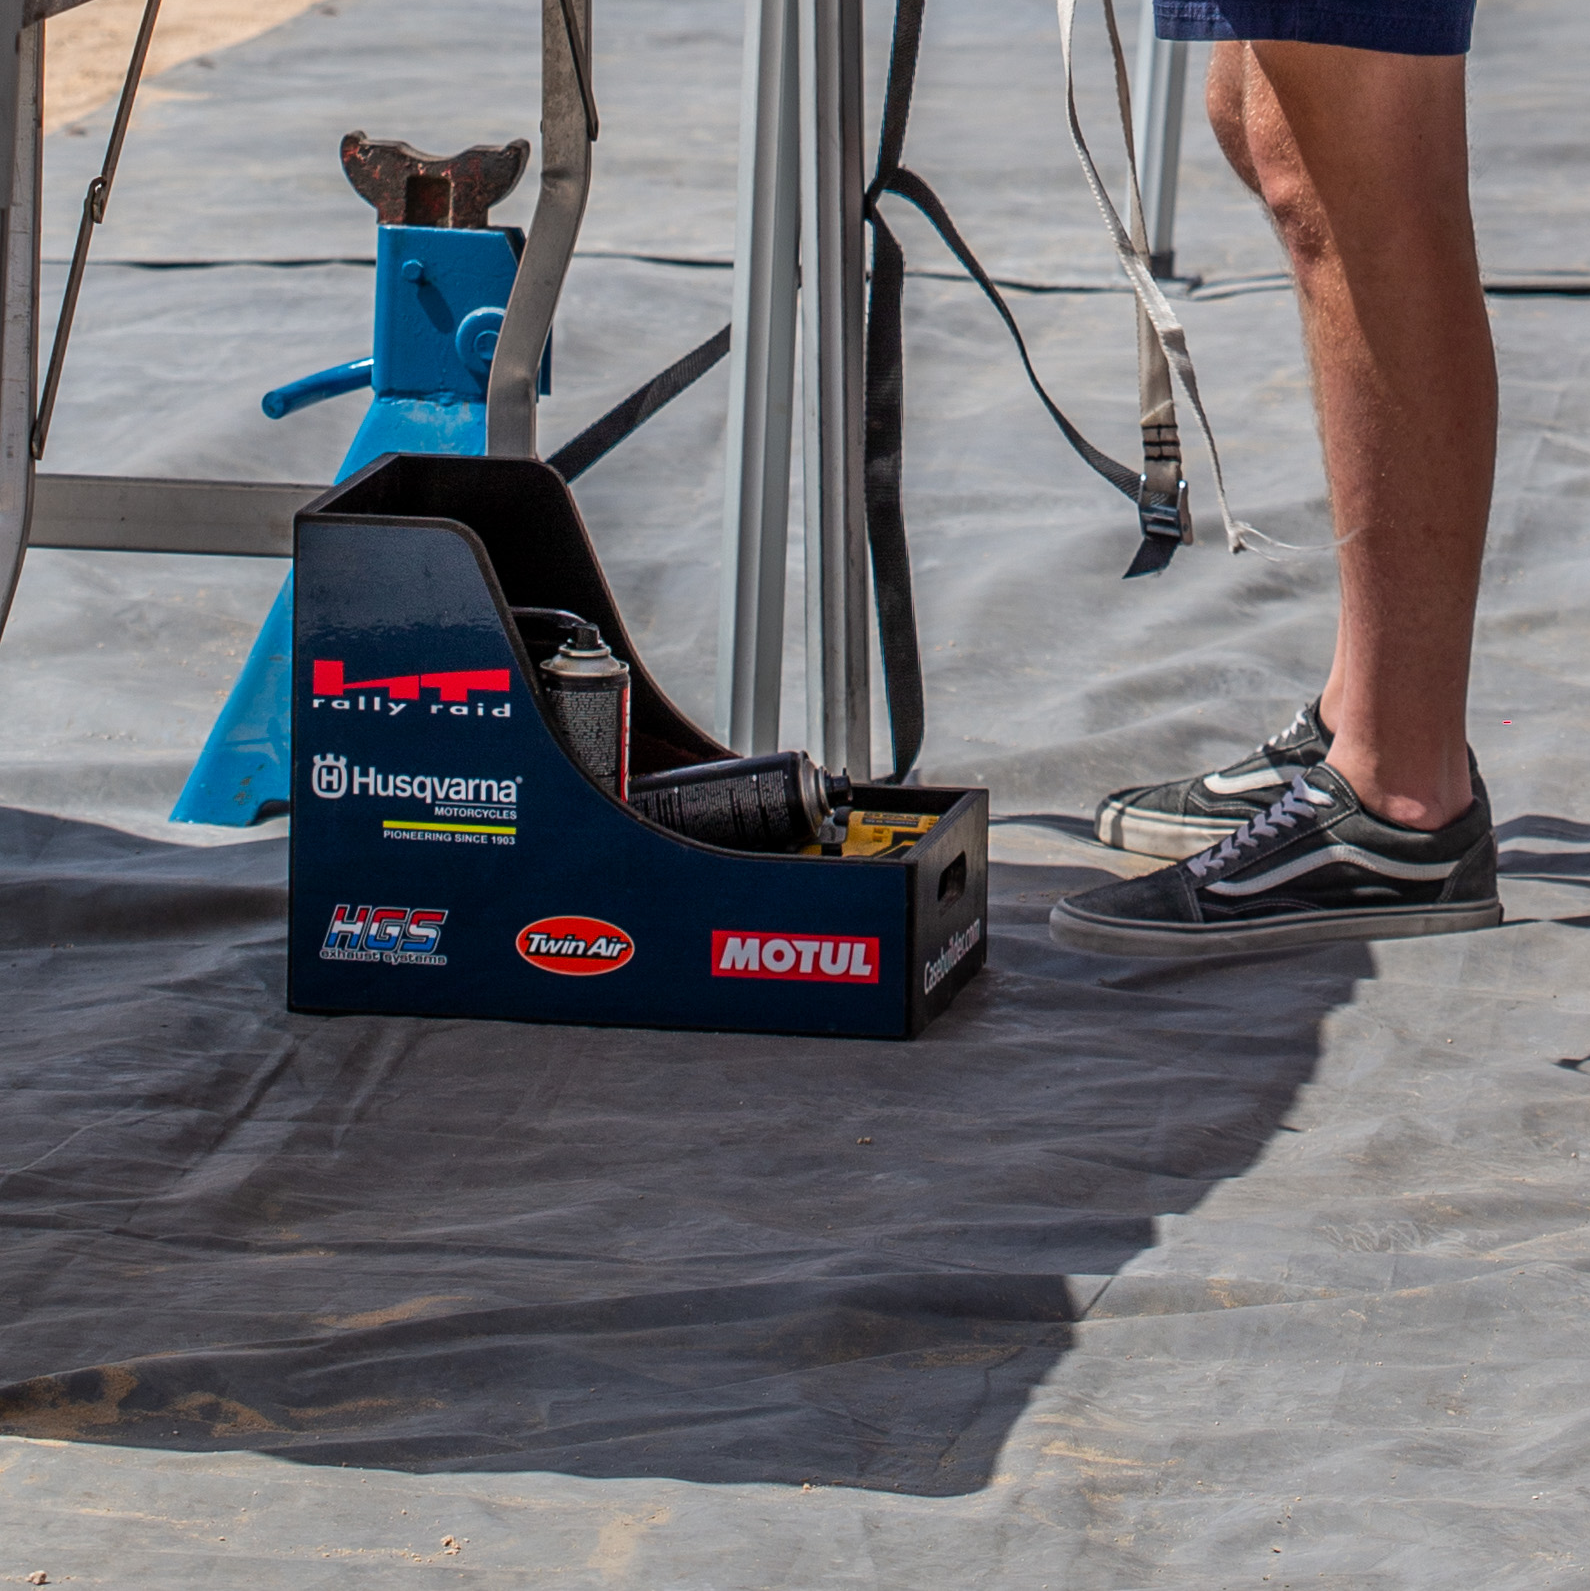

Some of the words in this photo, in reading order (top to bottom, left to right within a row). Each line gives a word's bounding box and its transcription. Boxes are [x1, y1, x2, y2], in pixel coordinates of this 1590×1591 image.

[312, 695, 407, 716] rally
[430, 702, 511, 718] raid
[353, 765, 518, 804] Husqvarna
[434, 806, 517, 820] MOTORCYCLES
[383, 829, 452, 843] PIONEERING
[454, 832, 488, 844] SINCE
[491, 835, 516, 846] 1903
[321, 905, 448, 954] HGS
[526, 932, 585, 956] Twin
[588, 936, 630, 960] Air
[719, 936, 873, 977] MOTUL
